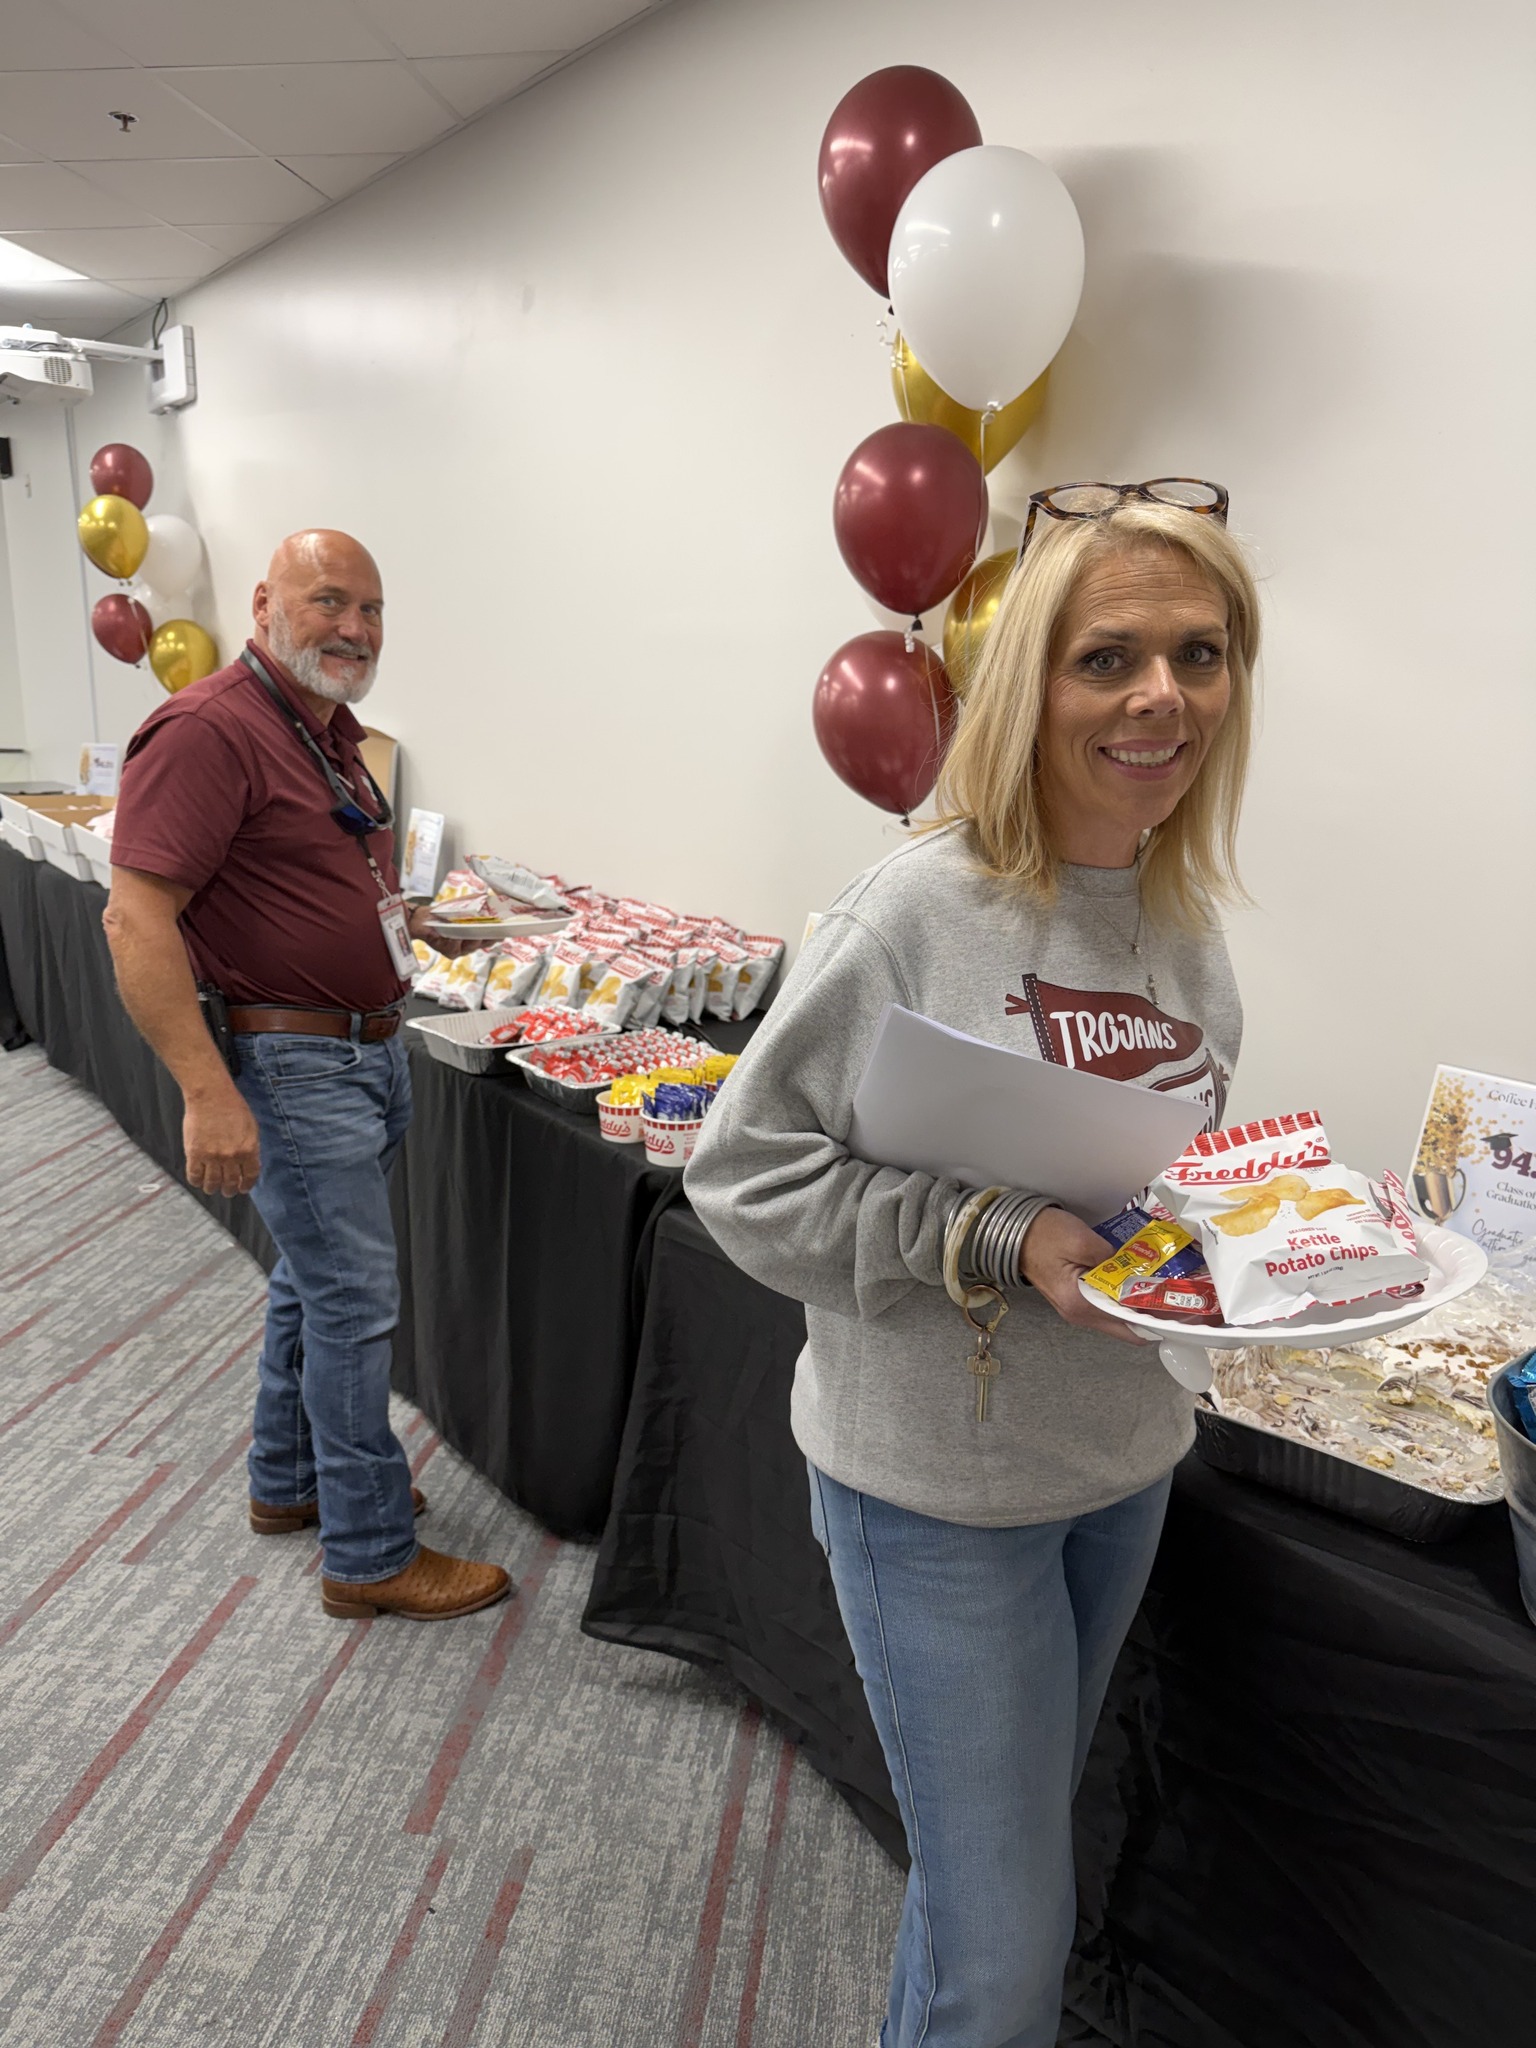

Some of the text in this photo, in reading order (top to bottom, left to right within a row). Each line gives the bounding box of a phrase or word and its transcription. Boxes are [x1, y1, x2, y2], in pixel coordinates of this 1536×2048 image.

[1050, 1011, 1177, 1070] TROJANS
[1488, 1089, 1528, 1107] Coffee
[1164, 1141, 1332, 1186] Freddy's
[1491, 1148, 1536, 1179] 94.
[1486, 1189, 1536, 1211] Graduatio
[1496, 1181, 1524, 1196] Class
[1287, 1233, 1341, 1251] Kettle
[1265, 1252, 1326, 1278] Potato
[1330, 1244, 1379, 1262] Chips
